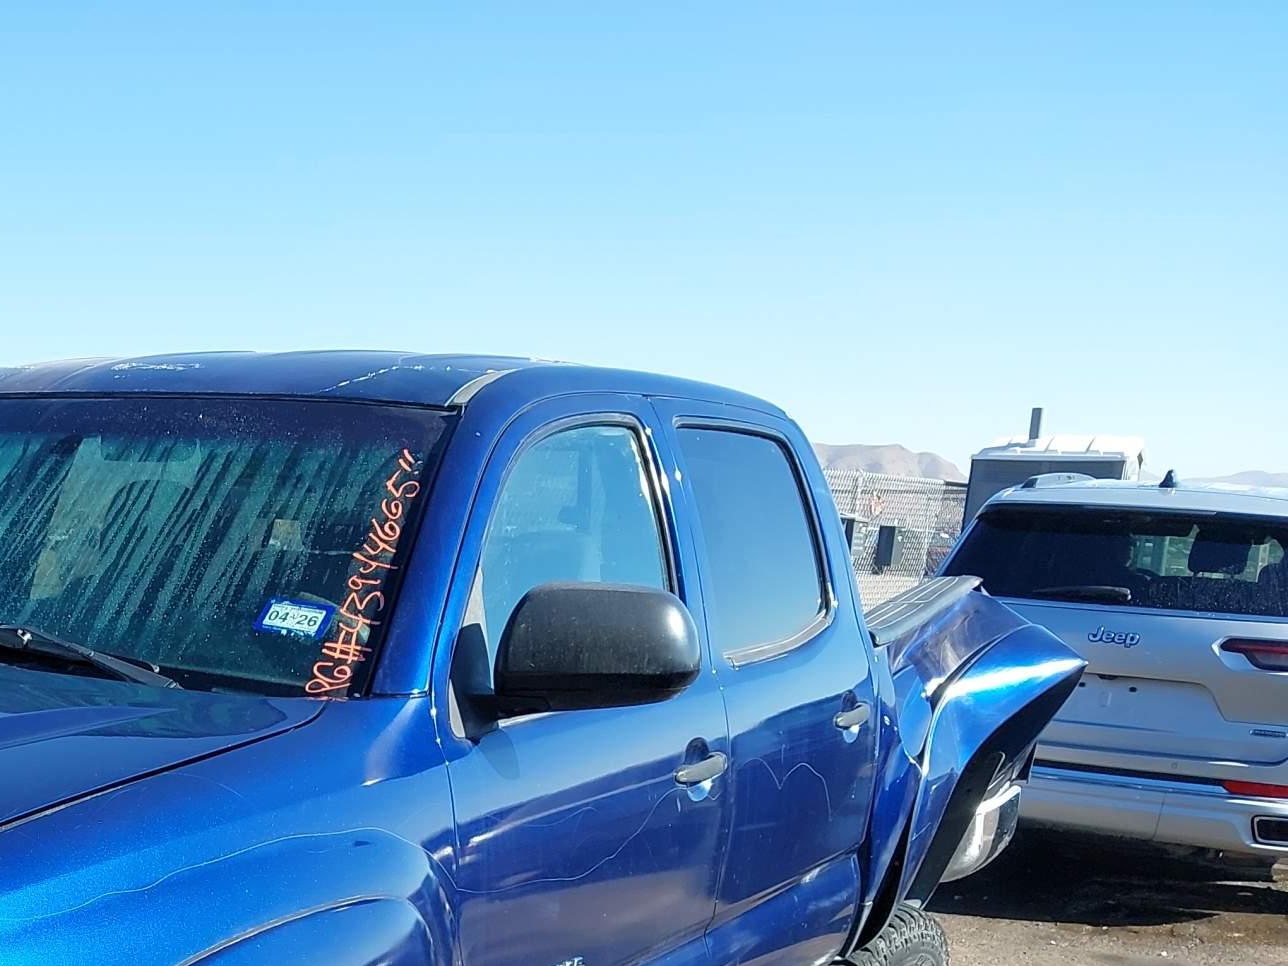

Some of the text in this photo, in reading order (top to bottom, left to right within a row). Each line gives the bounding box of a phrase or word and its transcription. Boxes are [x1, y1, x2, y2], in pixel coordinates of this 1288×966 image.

[268, 610, 319, 627] 04 26
[1088, 625, 1140, 648] Jeep
